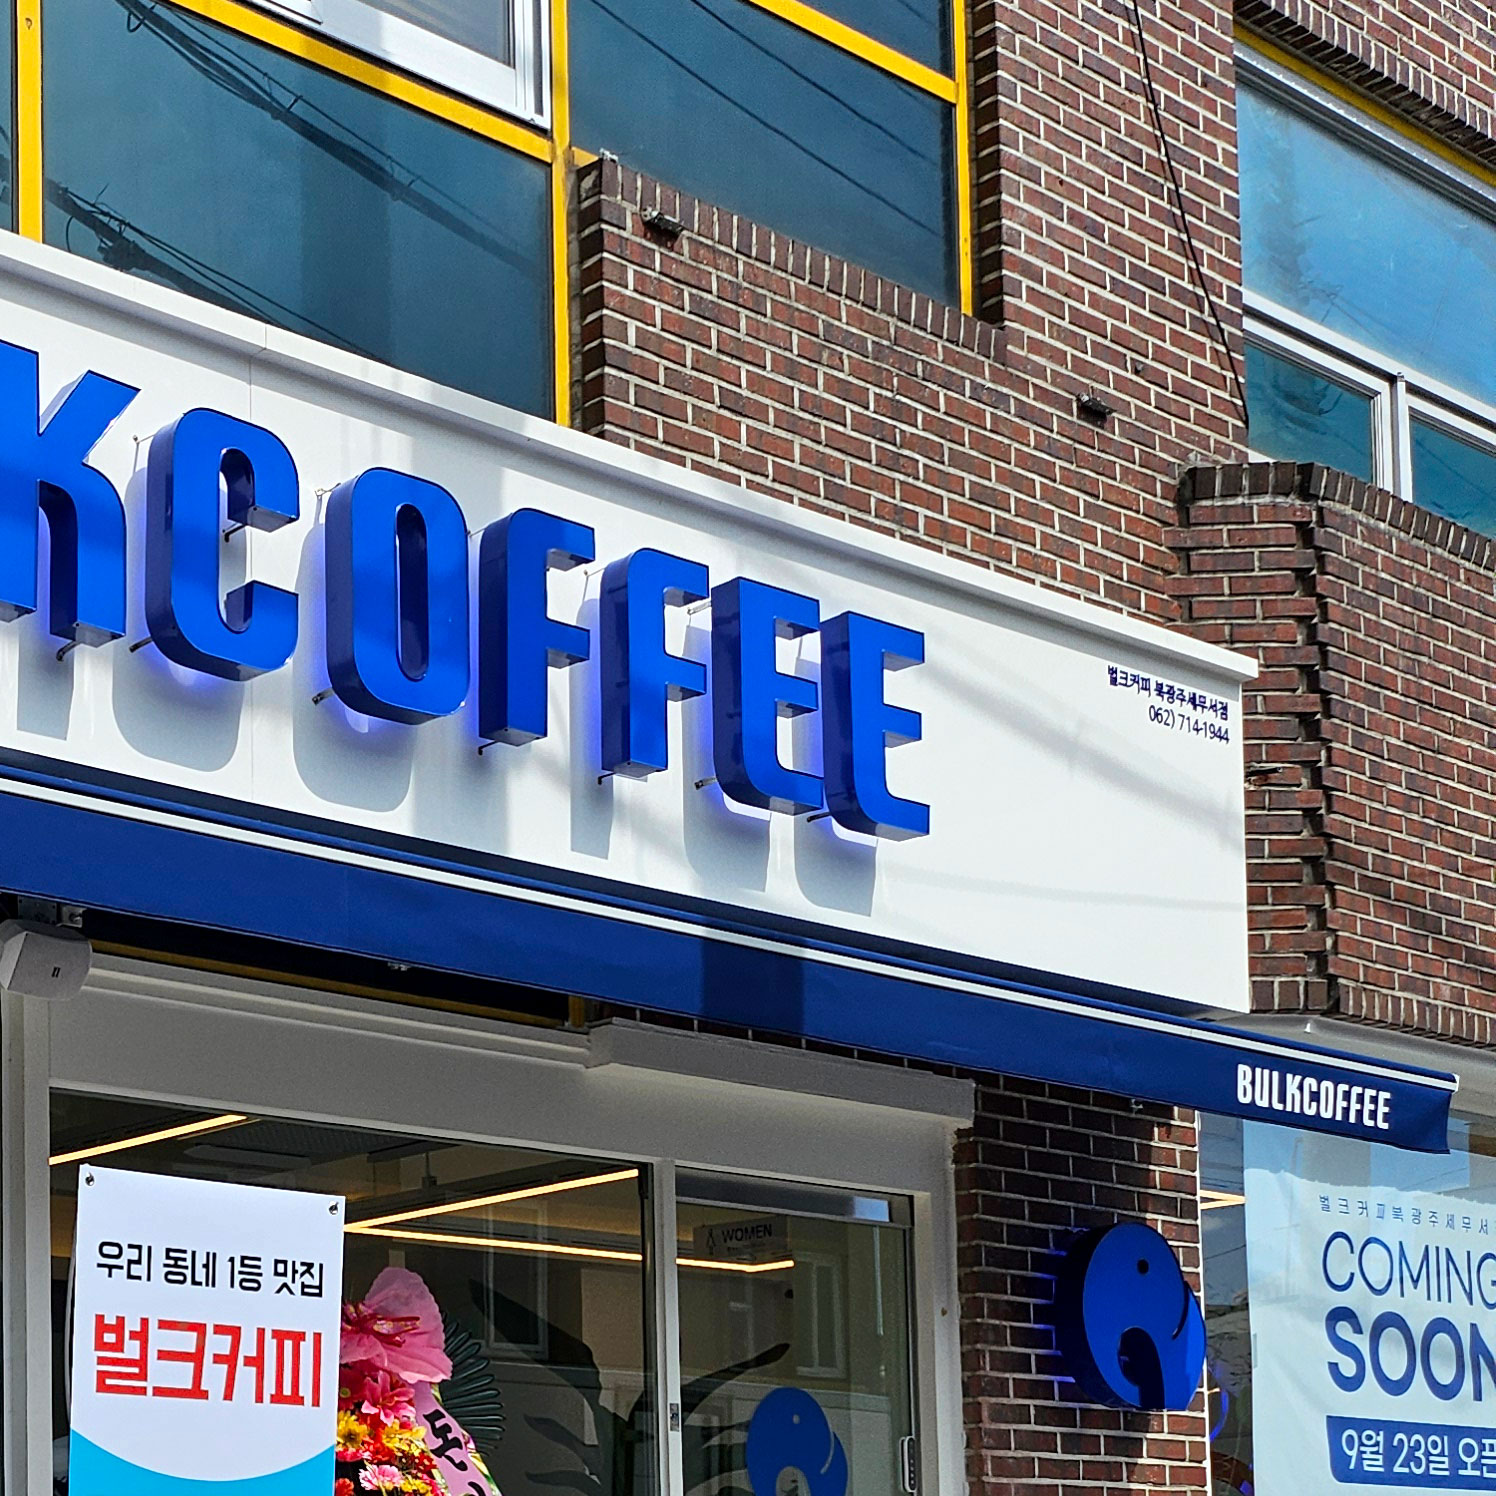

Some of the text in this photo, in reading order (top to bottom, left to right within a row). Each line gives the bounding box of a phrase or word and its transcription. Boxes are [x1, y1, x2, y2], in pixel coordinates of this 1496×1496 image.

[1107, 665, 1229, 721] 벌크커피 북광주세무서점
[1149, 705, 1230, 744] 062) 714-1944
[1237, 1063, 1393, 1130] BULKCOFFEE
[721, 1223, 772, 1243] WOMEN
[97, 1240, 324, 1298] 우리 동네 1등 맛집
[93, 1313, 323, 1408] 벌크커피
[1341, 1429, 1385, 1472] 9월
[1393, 1433, 1450, 1476] 23일
